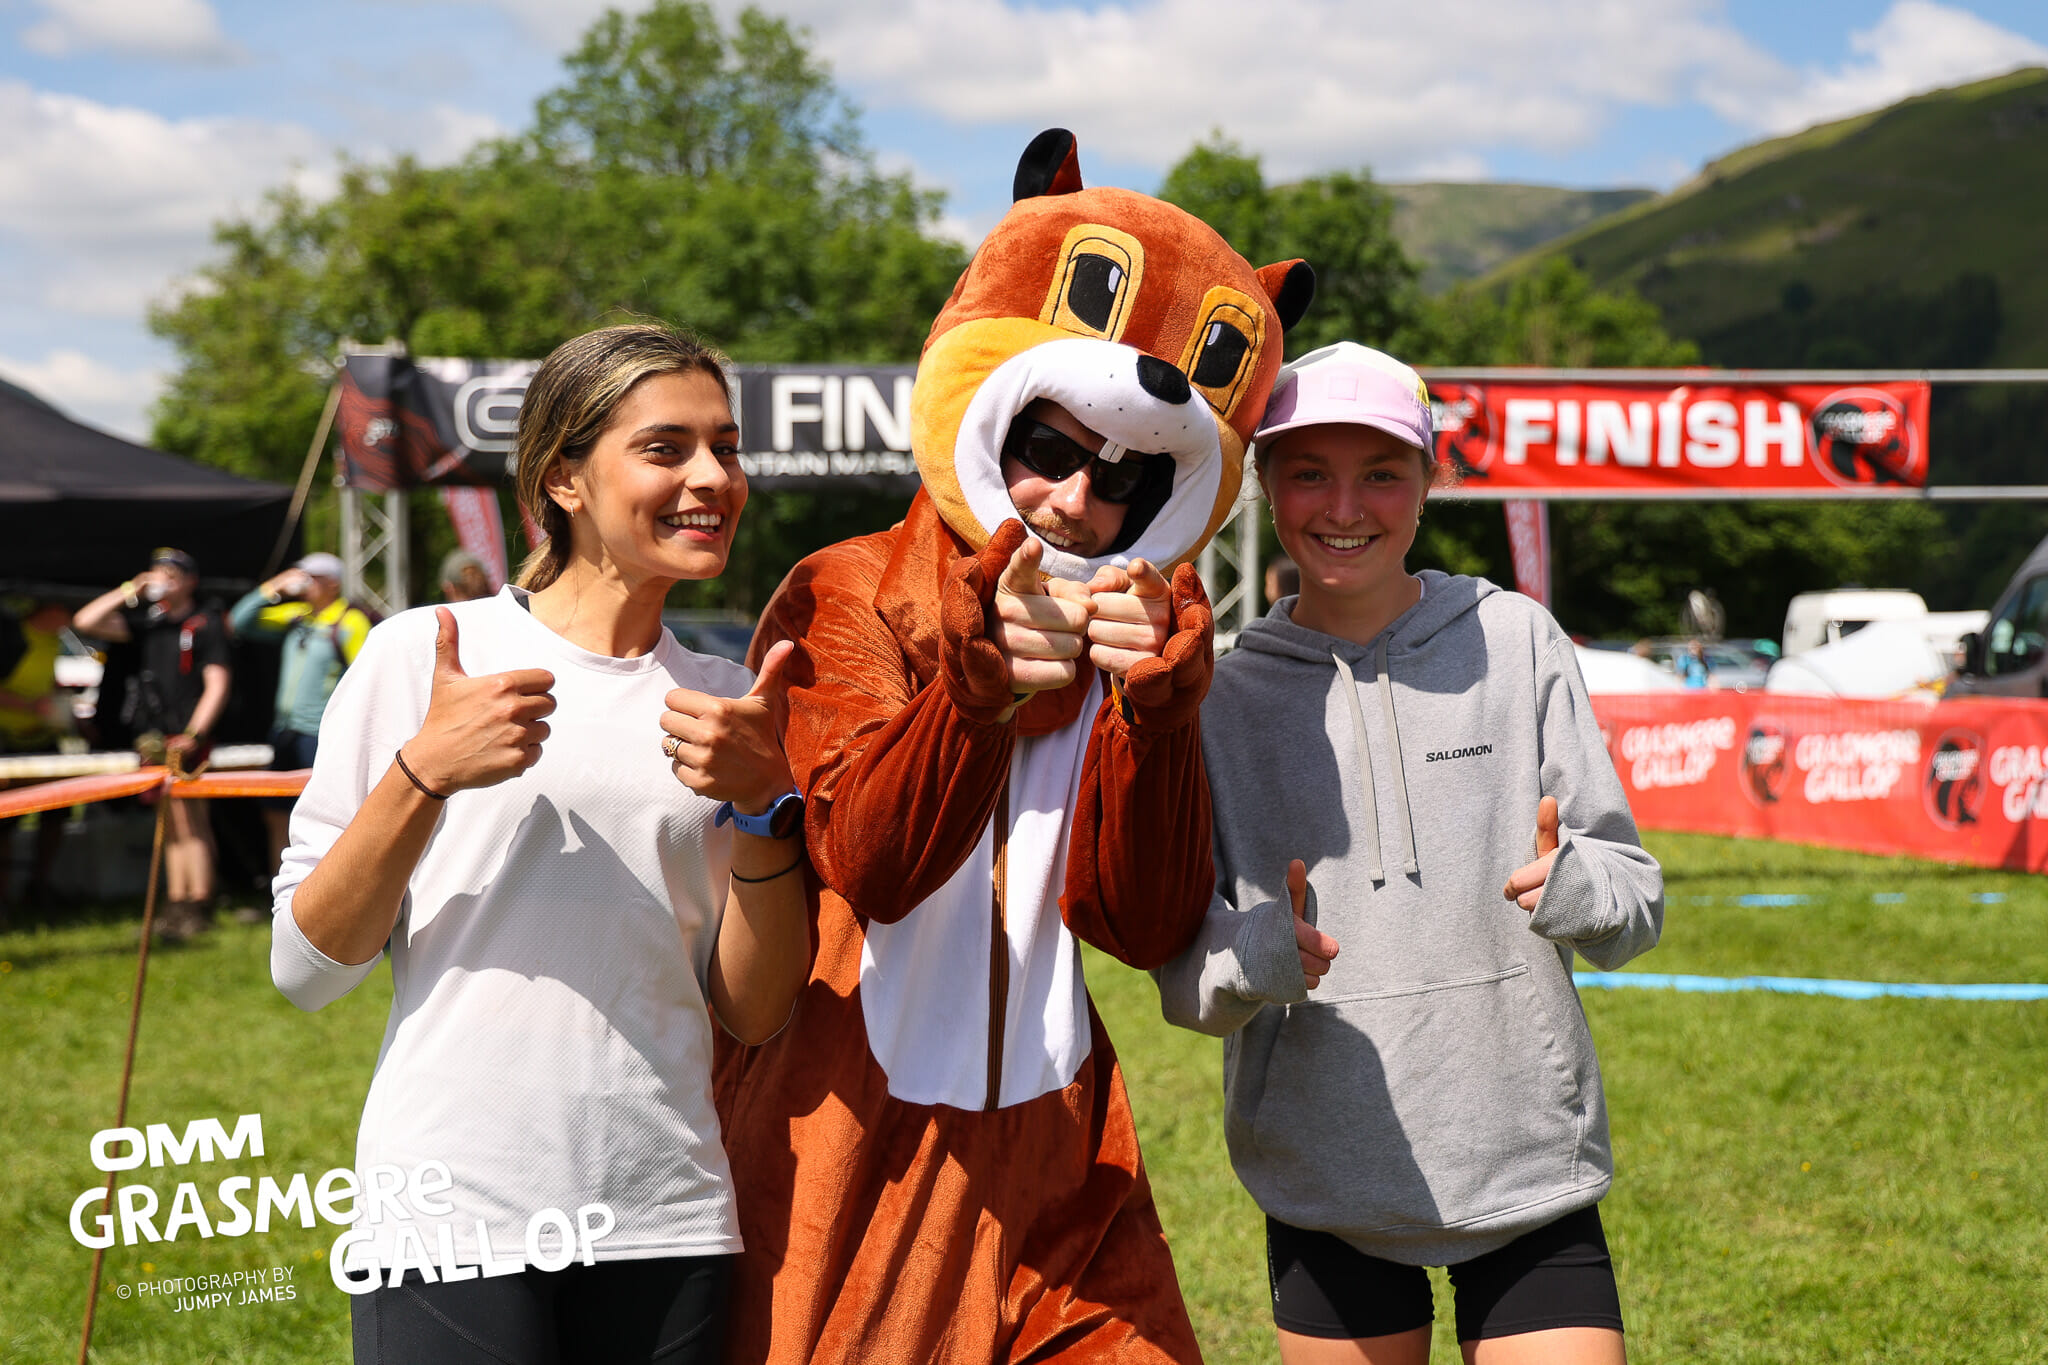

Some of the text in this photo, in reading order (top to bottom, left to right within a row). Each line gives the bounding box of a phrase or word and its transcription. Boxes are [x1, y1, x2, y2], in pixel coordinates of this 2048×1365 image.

[771, 375, 915, 451] FIN
[1503, 399, 1804, 468] FINISH
[1425, 744, 1492, 763] SALOMON
